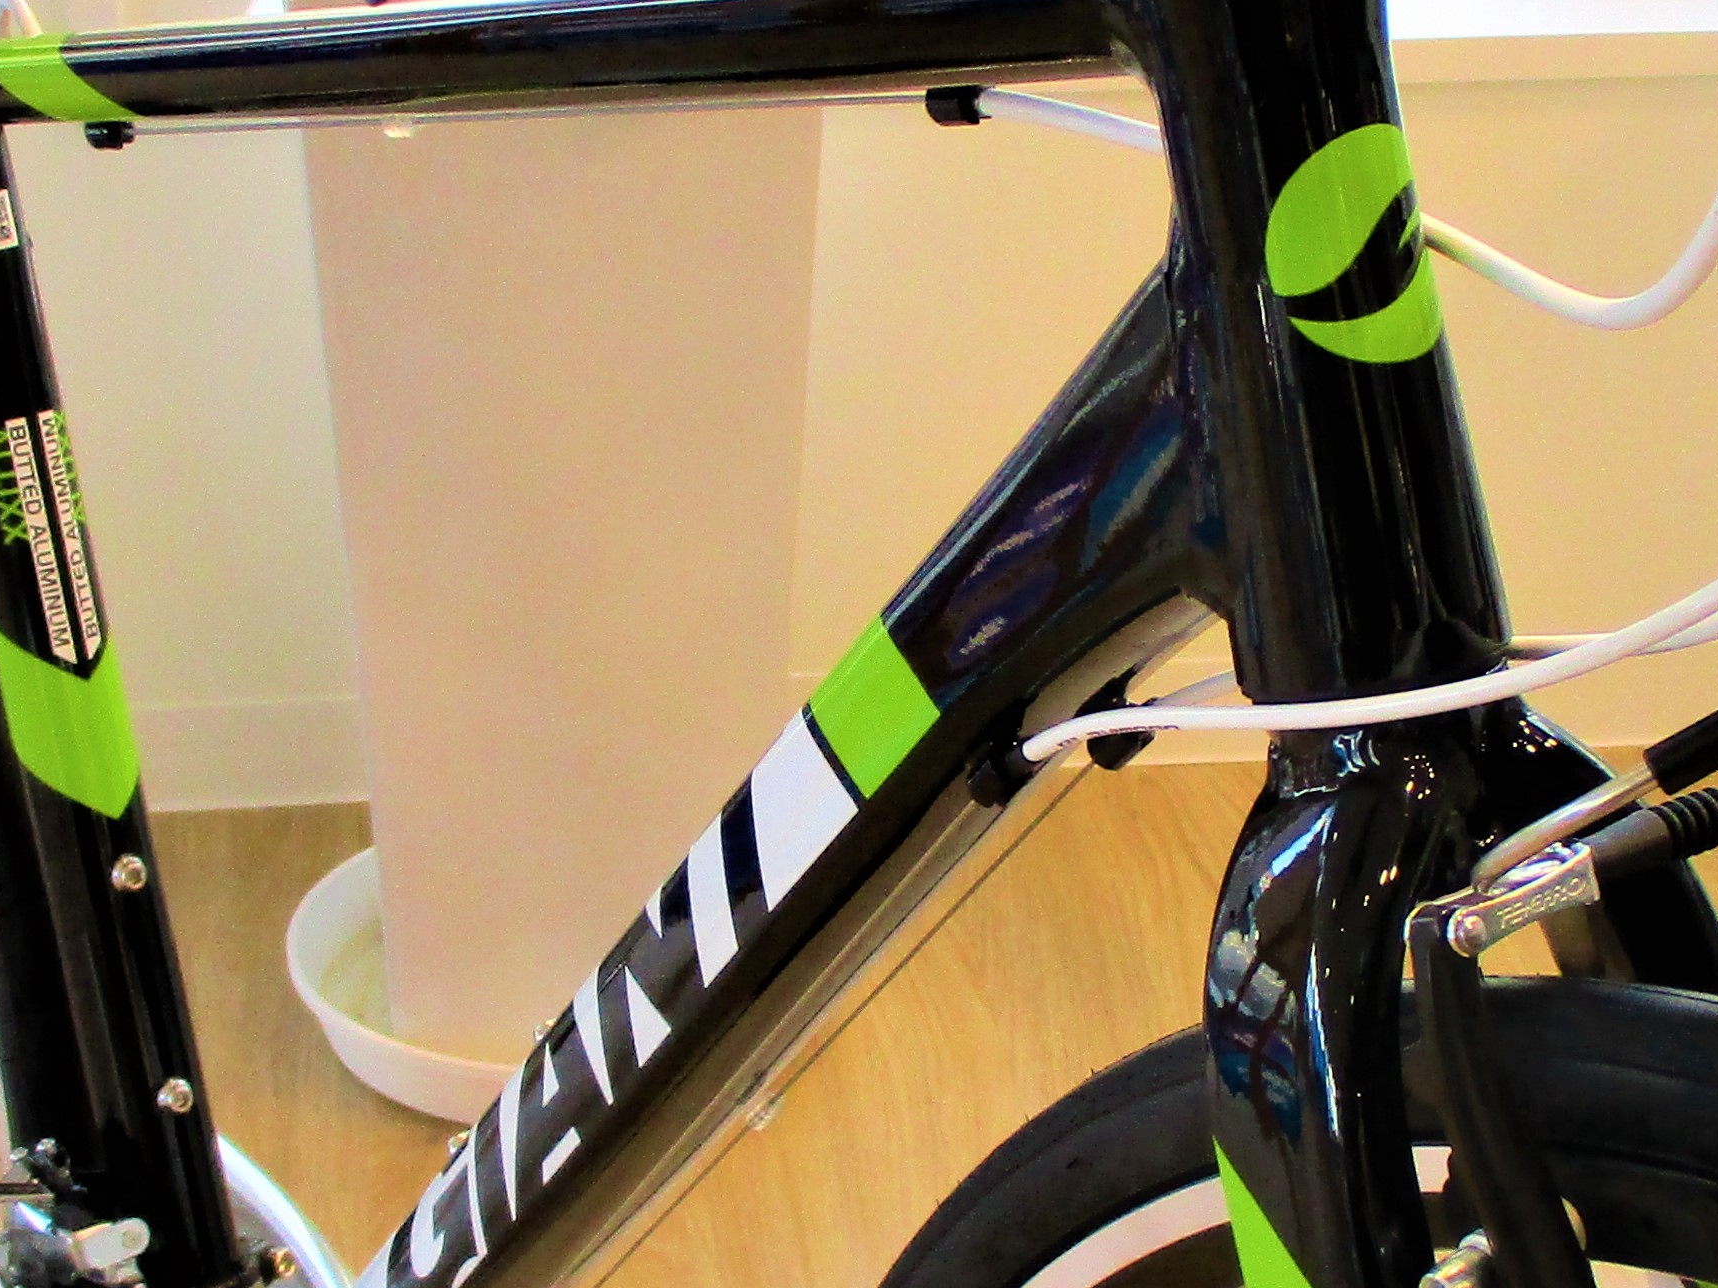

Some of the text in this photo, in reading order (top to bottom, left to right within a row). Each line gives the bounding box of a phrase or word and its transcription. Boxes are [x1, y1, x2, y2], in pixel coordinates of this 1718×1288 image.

[9, 423, 45, 516] BUTTED
[29, 523, 71, 648] ALUMINUM
[41, 417, 79, 540] ALUMINUM
[69, 549, 98, 640] BUTTED
